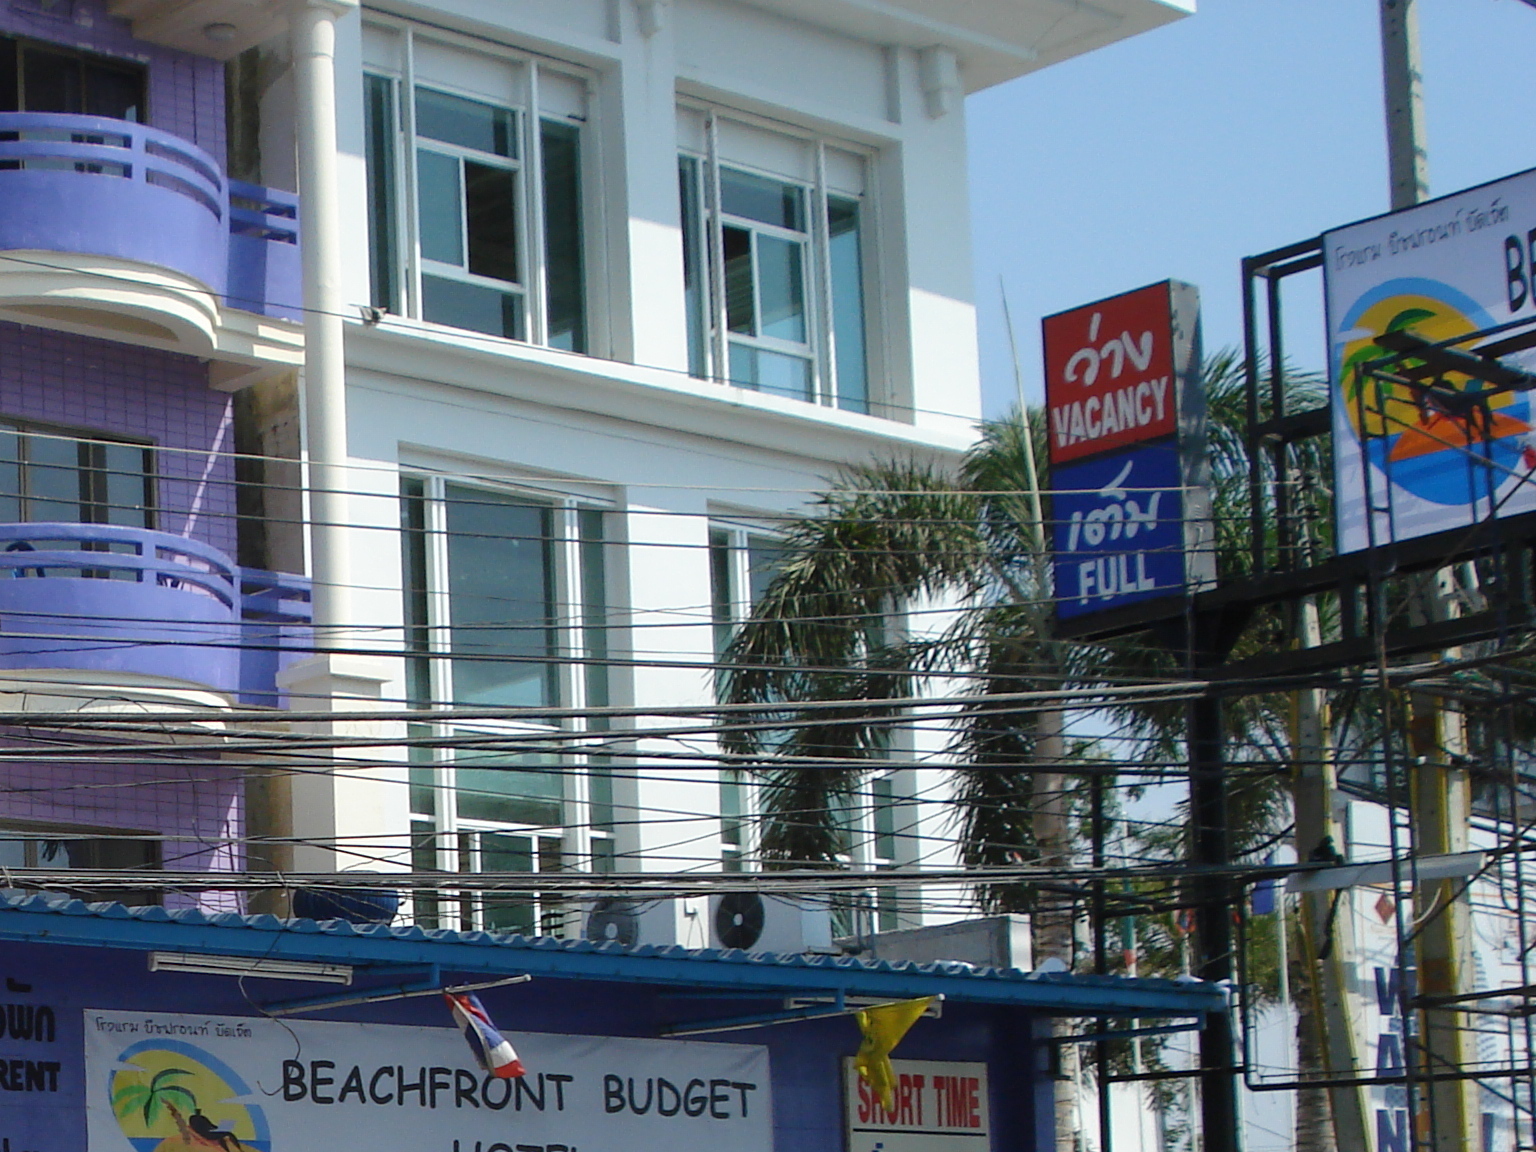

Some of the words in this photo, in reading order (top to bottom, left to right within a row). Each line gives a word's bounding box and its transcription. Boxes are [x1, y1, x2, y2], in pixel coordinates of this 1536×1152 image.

[1064, 312, 1154, 386] ว่าง
[1052, 376, 1169, 449] VACANCY
[1067, 459, 1161, 552] เต็ม
[1078, 549, 1156, 606] FULL
[282, 1059, 573, 1112] BEACHFRONT
[602, 1073, 757, 1119] BUDGET
[933, 1075, 981, 1128] TIME
